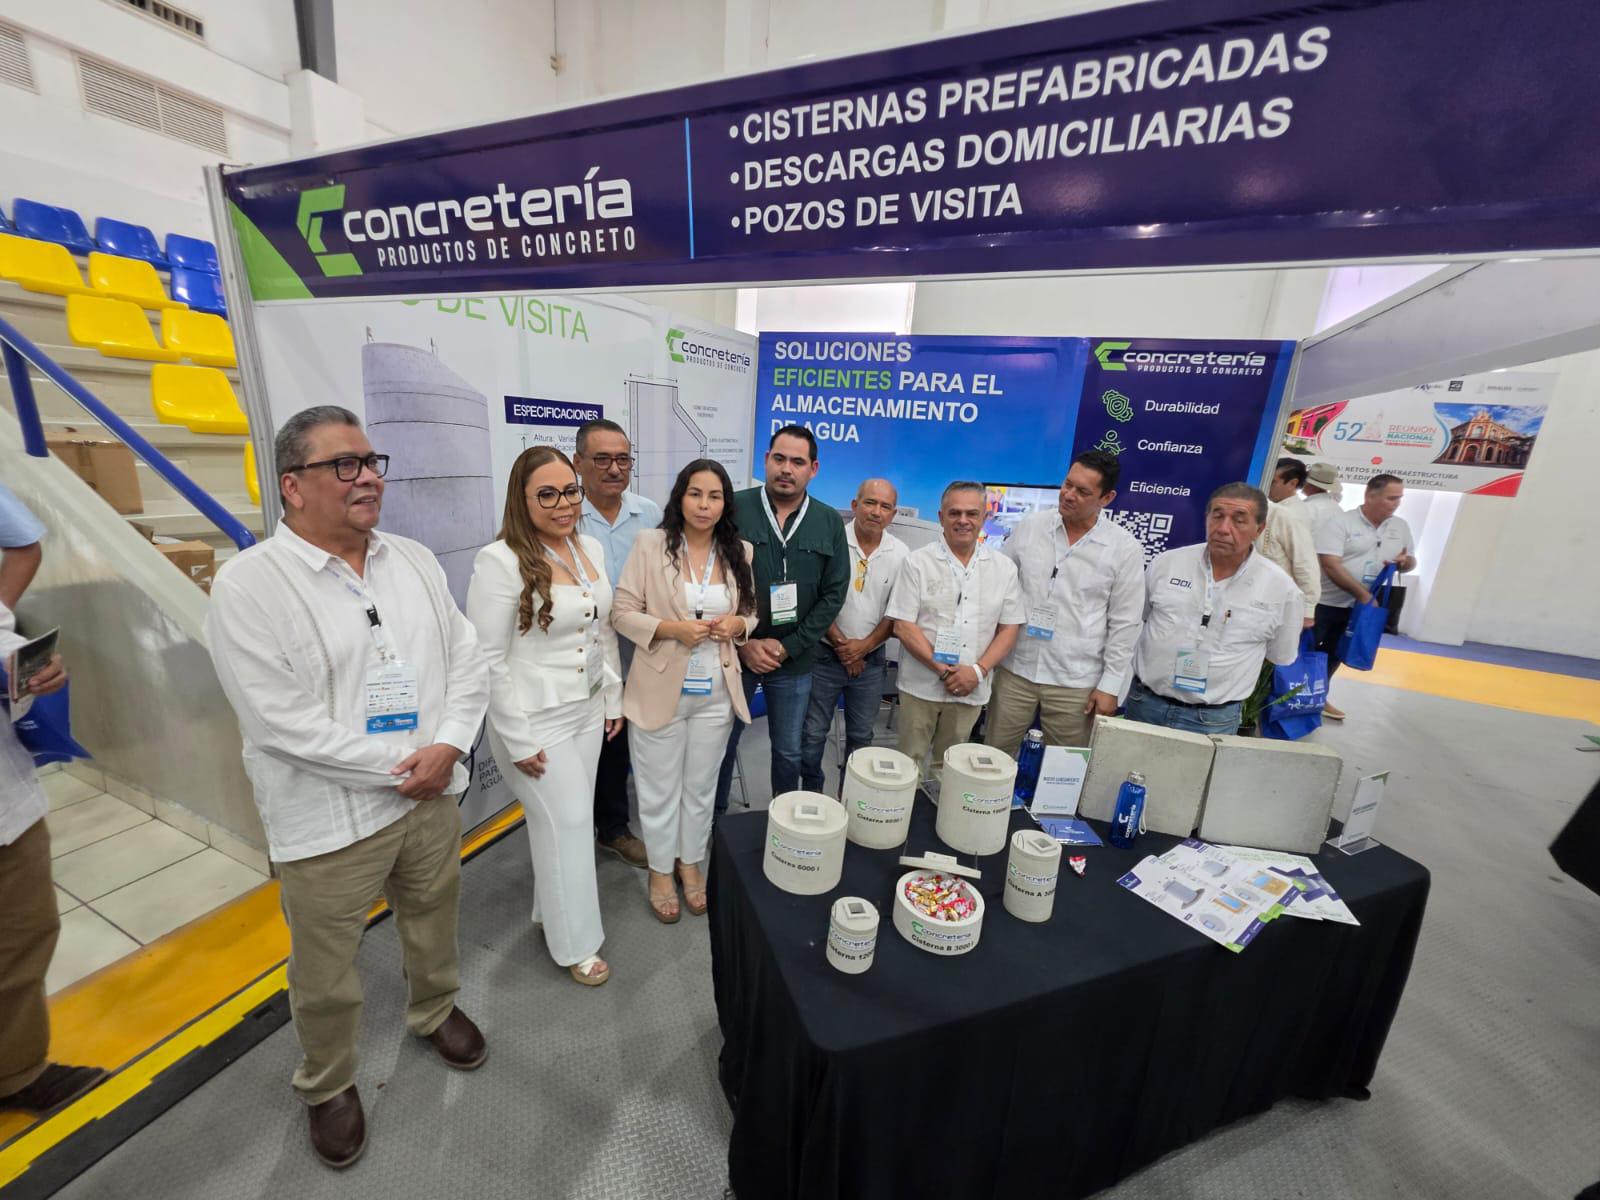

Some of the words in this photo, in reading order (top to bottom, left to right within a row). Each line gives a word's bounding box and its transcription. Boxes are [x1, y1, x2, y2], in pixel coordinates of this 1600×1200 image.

[743, 88, 927, 144] CISTERNAS
[938, 26, 1331, 118] PREFABRICADAS
[745, 138, 945, 190] DESCARGAS
[956, 97, 1294, 169] DOMICILIARIAS
[343, 166, 633, 242] concretería
[745, 198, 845, 235] POZOS
[856, 194, 900, 227] DE
[910, 182, 1023, 223] VISITA
[378, 239, 476, 268] PRODUCTOS
[487, 236, 510, 260] DE
[520, 226, 636, 258] CONCRETO
[499, 296, 589, 342] VISITA
[682, 342, 751, 367] concretería
[774, 341, 912, 362] SOLUCIONES
[1123, 351, 1266, 367] concretería
[686, 355, 715, 368] PRODUCTOS
[717, 361, 723, 369] DE
[1137, 365, 1191, 374] PRODUCTOS
[1196, 366, 1207, 374] DE
[1212, 366, 1263, 376] CONCRETO
[773, 368, 892, 390] EFICIENTES
[899, 371, 965, 394] PARA
[971, 374, 1004, 395] EL
[513, 404, 599, 421] ESPECIFICACIONES
[771, 394, 979, 423] ALMACENAMIENTO
[1144, 400, 1220, 415] Durabilidad
[804, 421, 860, 443] AGUA
[1386, 432, 1434, 441] NACIONAL
[1137, 439, 1203, 454] Confianza
[1345, 465, 1370, 475] RETOS
[1372, 468, 1383, 476] EN
[1384, 468, 1459, 480] INFRAESTRUCTURA
[1129, 481, 1191, 497] Eficiencia
[479, 766, 499, 782] PAR
[857, 813, 883, 824] Cisterna
[962, 805, 991, 815] Cisterna
[771, 851, 796, 869] Cisterna
[797, 864, 816, 872] 6000
[911, 934, 945, 951] Cisterna
